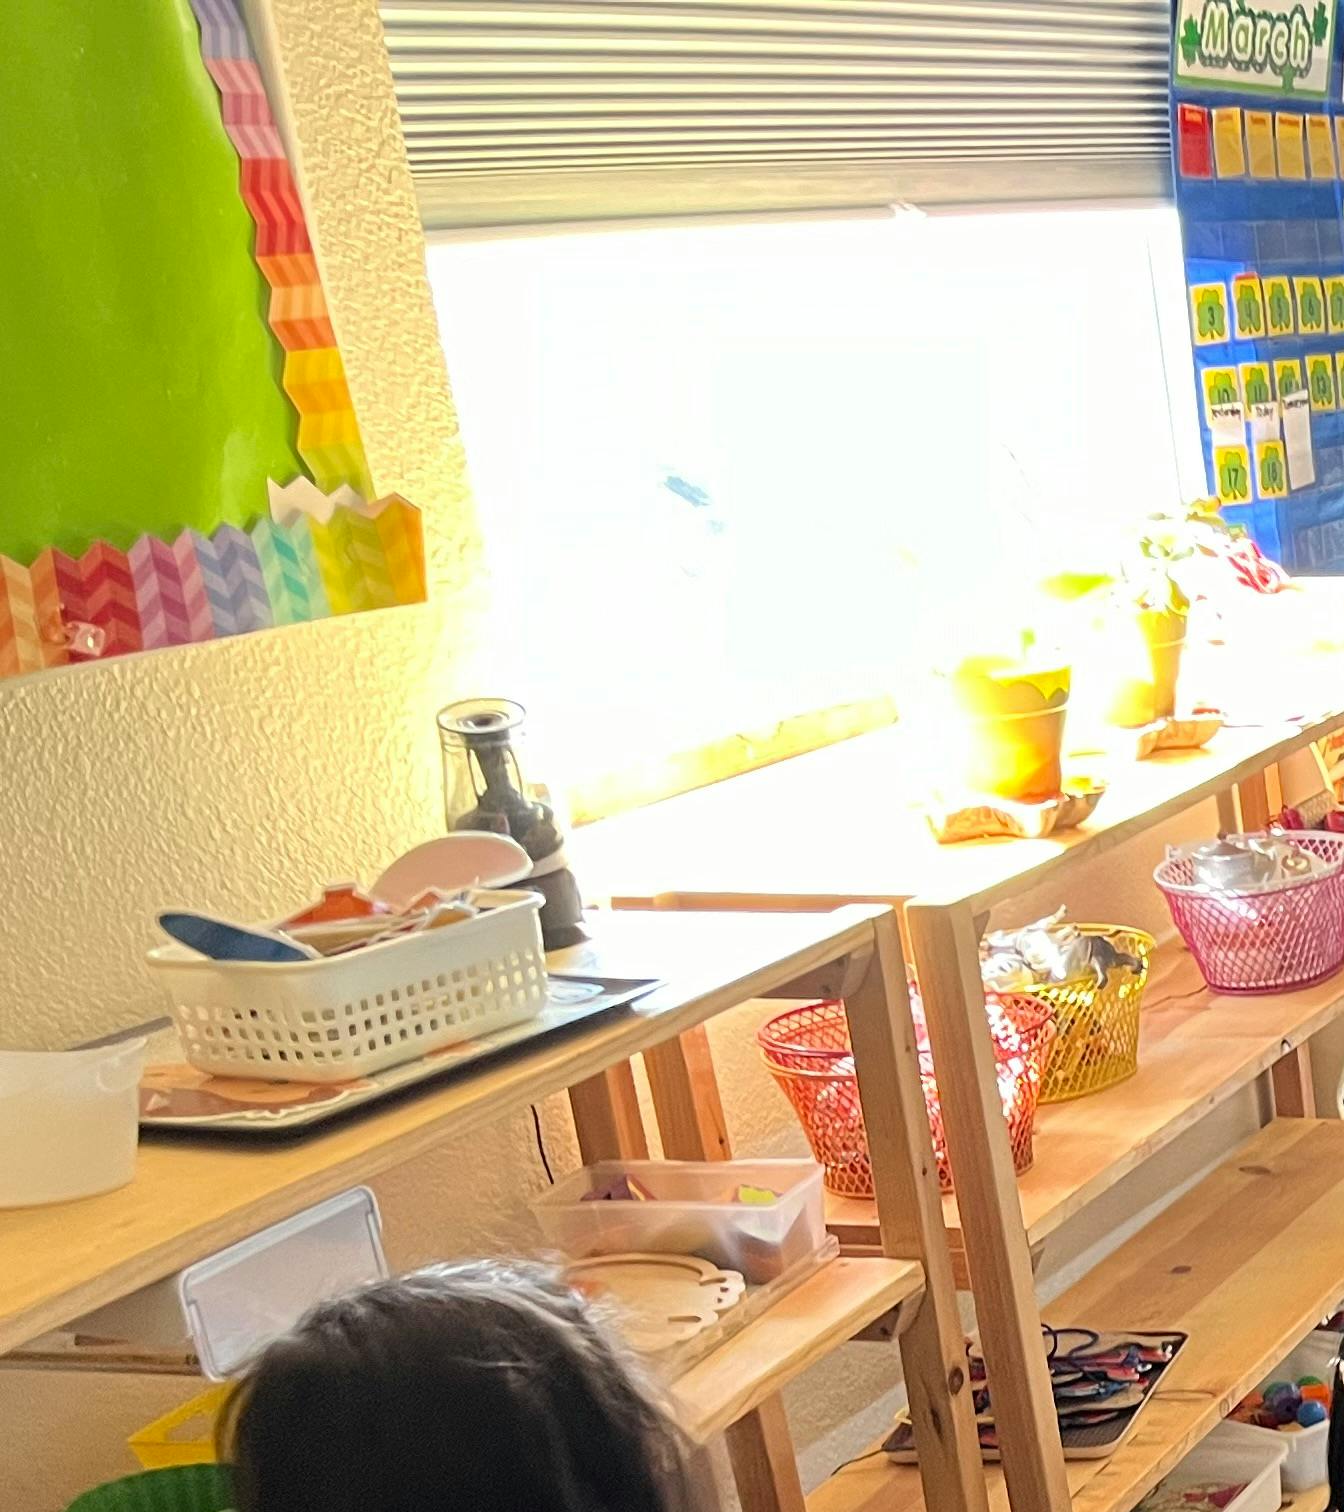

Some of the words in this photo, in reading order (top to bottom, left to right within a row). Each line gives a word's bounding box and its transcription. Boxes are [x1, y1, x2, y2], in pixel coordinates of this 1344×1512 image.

[1200, 1, 1312, 74] March
[1206, 306, 1216, 327] 3
[1307, 301, 1315, 318] 6
[1226, 466, 1240, 490] 17
